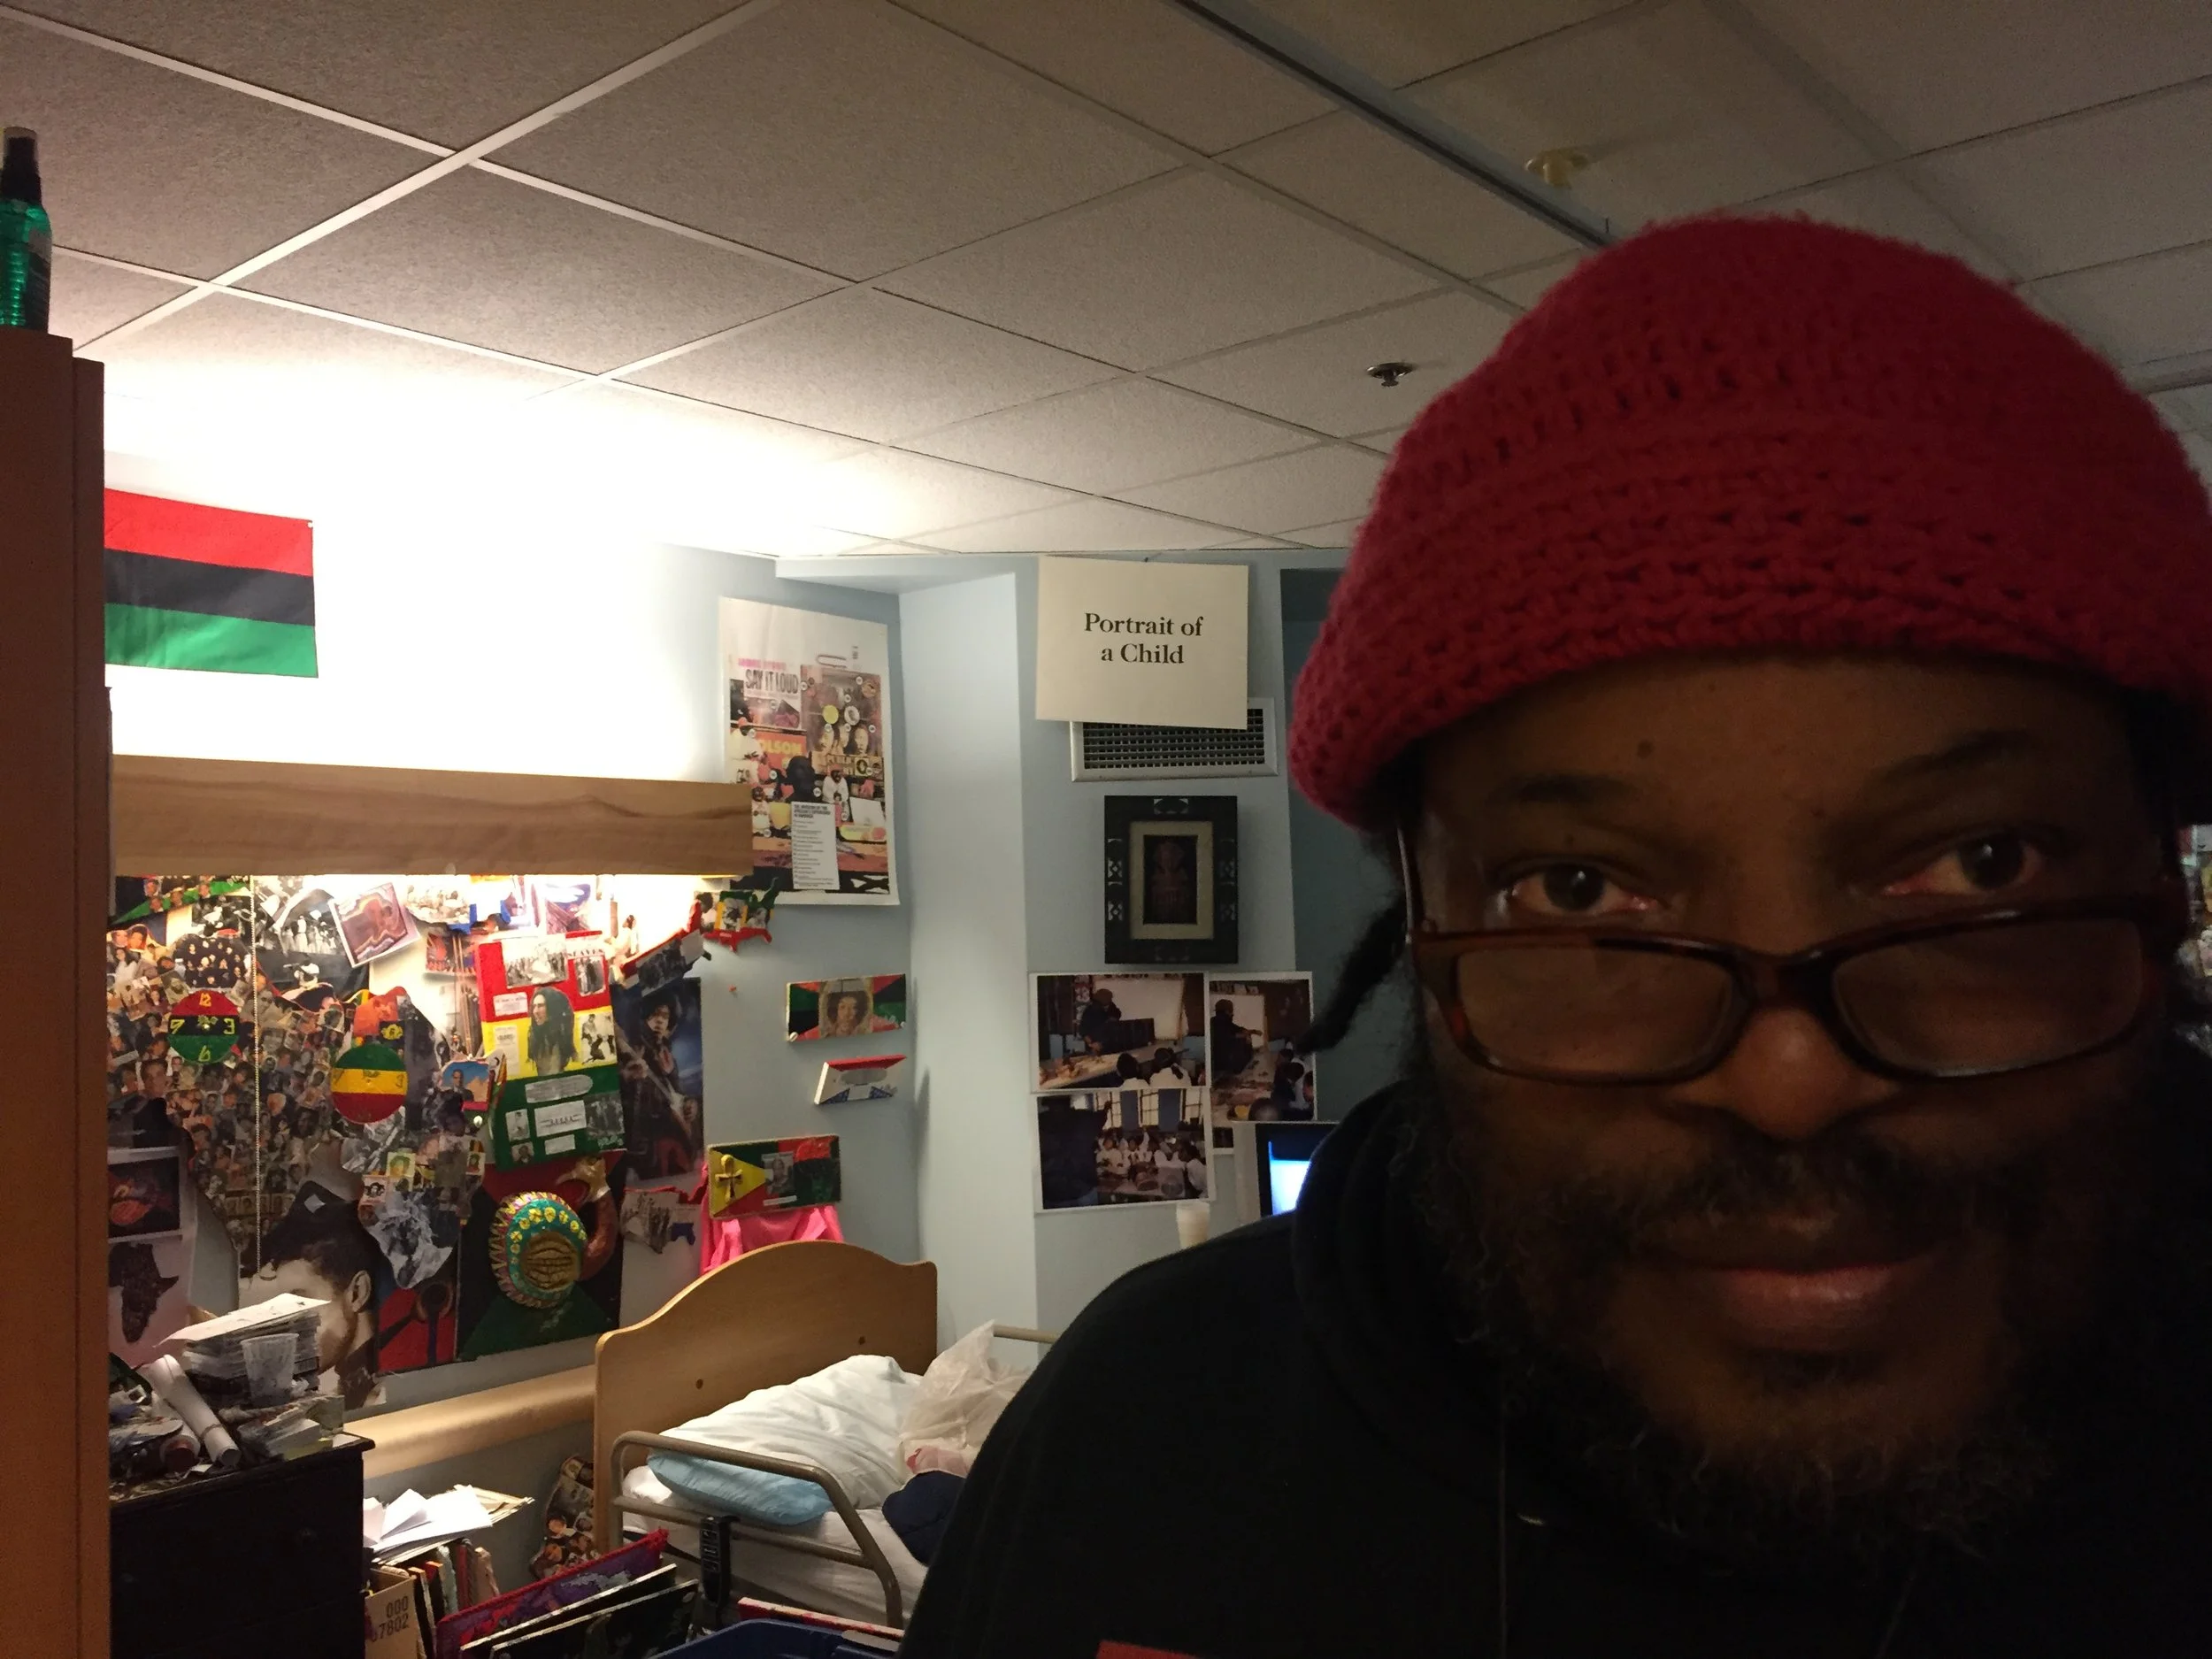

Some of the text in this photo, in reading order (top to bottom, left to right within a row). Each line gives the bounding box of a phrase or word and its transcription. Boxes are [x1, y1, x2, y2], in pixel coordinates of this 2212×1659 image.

[1085, 612, 1203, 636] Portrait of
[1101, 643, 1184, 664] a Child
[775, 672, 798, 694] LOUD
[223, 1018, 235, 1034] 3
